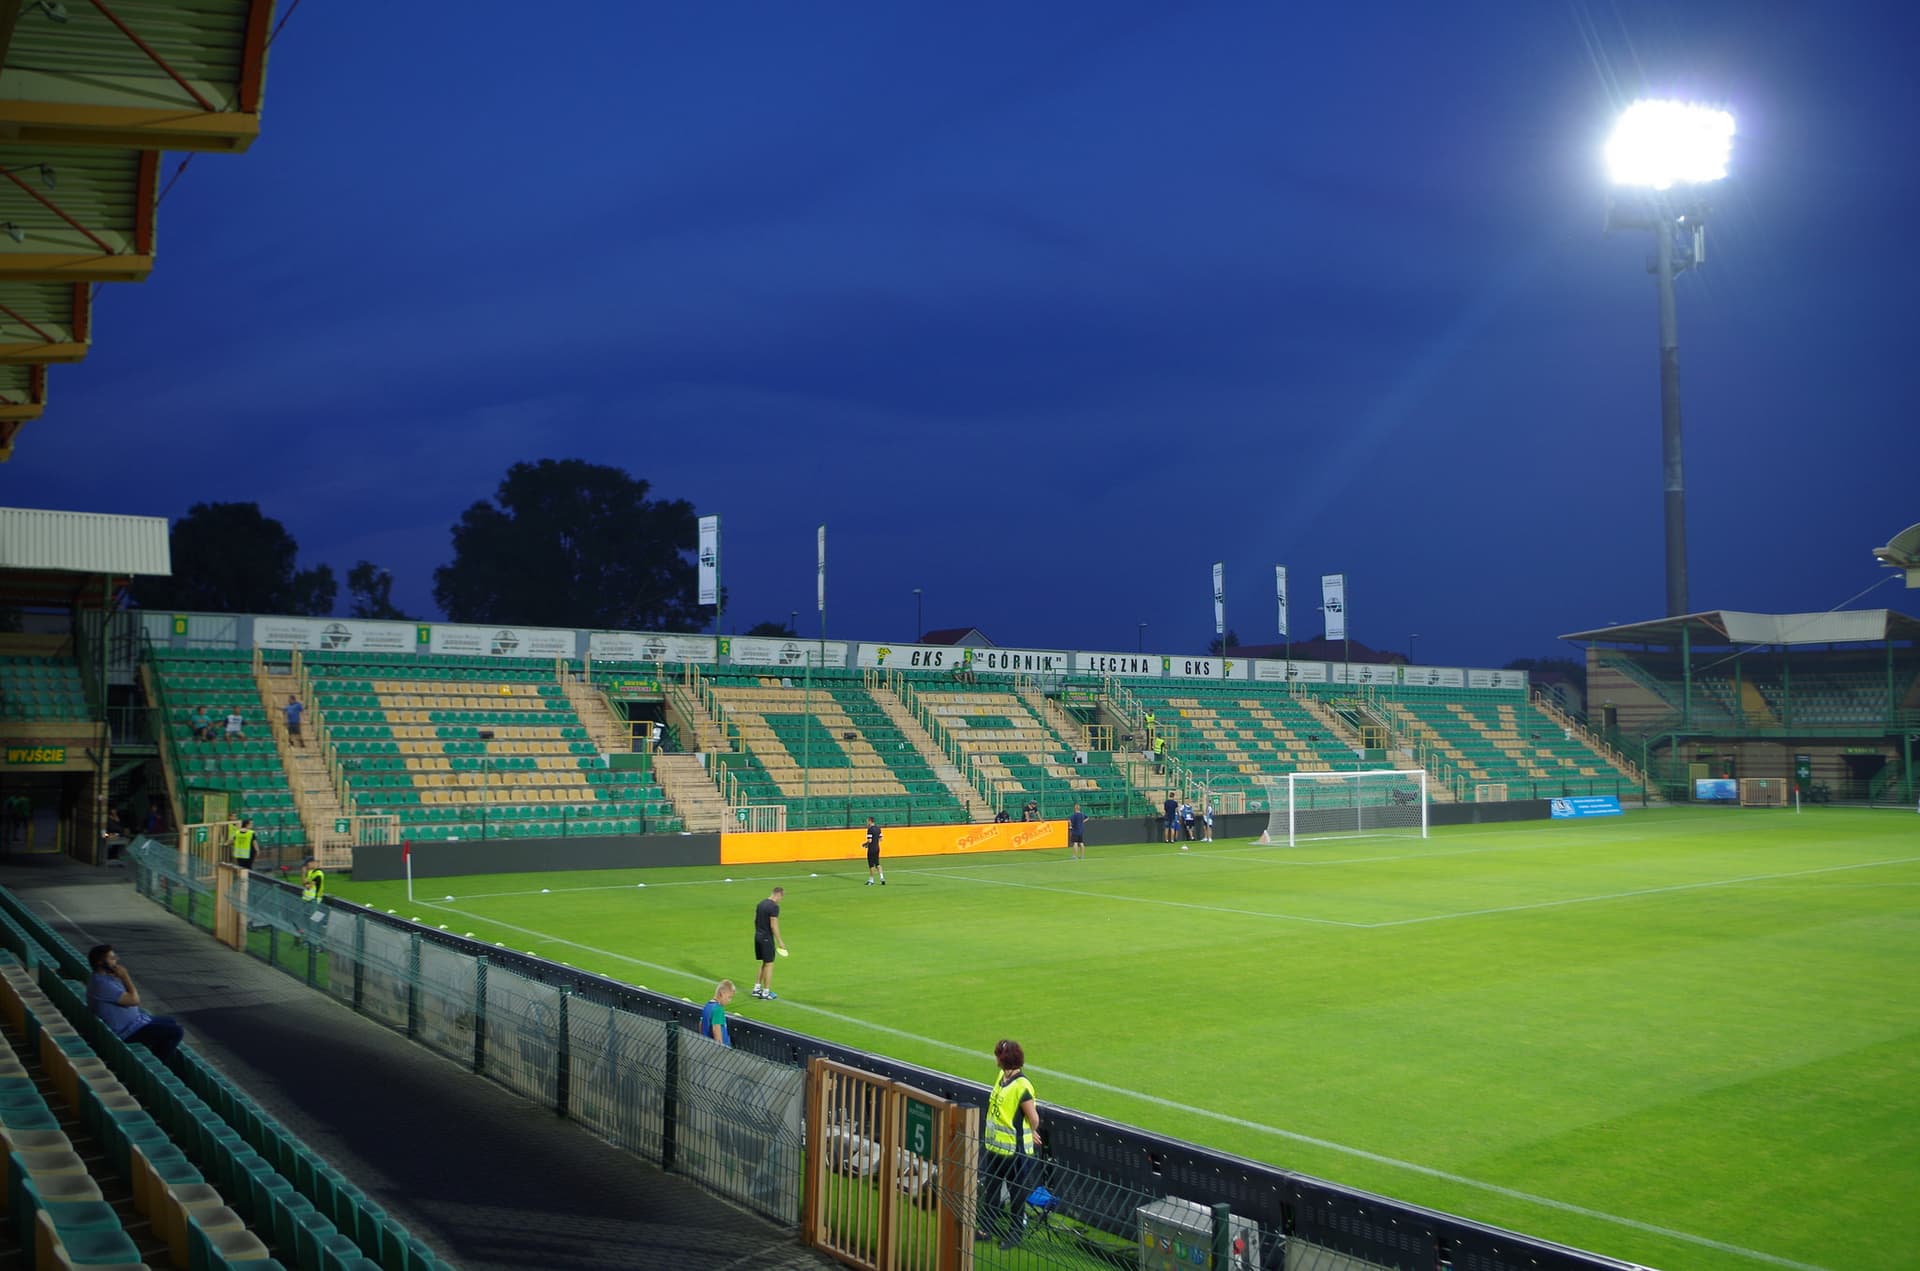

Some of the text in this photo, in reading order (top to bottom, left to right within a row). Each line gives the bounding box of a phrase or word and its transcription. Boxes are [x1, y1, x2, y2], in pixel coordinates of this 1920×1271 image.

[421, 631, 427, 641] 1
[721, 642, 728, 653] 2
[911, 650, 943, 666] GKS
[977, 652, 1061, 670] "GÓRNIK"
[1185, 660, 1210, 675] GKS
[9, 747, 64, 761] WYJŚCIE
[914, 1123, 925, 1153] 5
